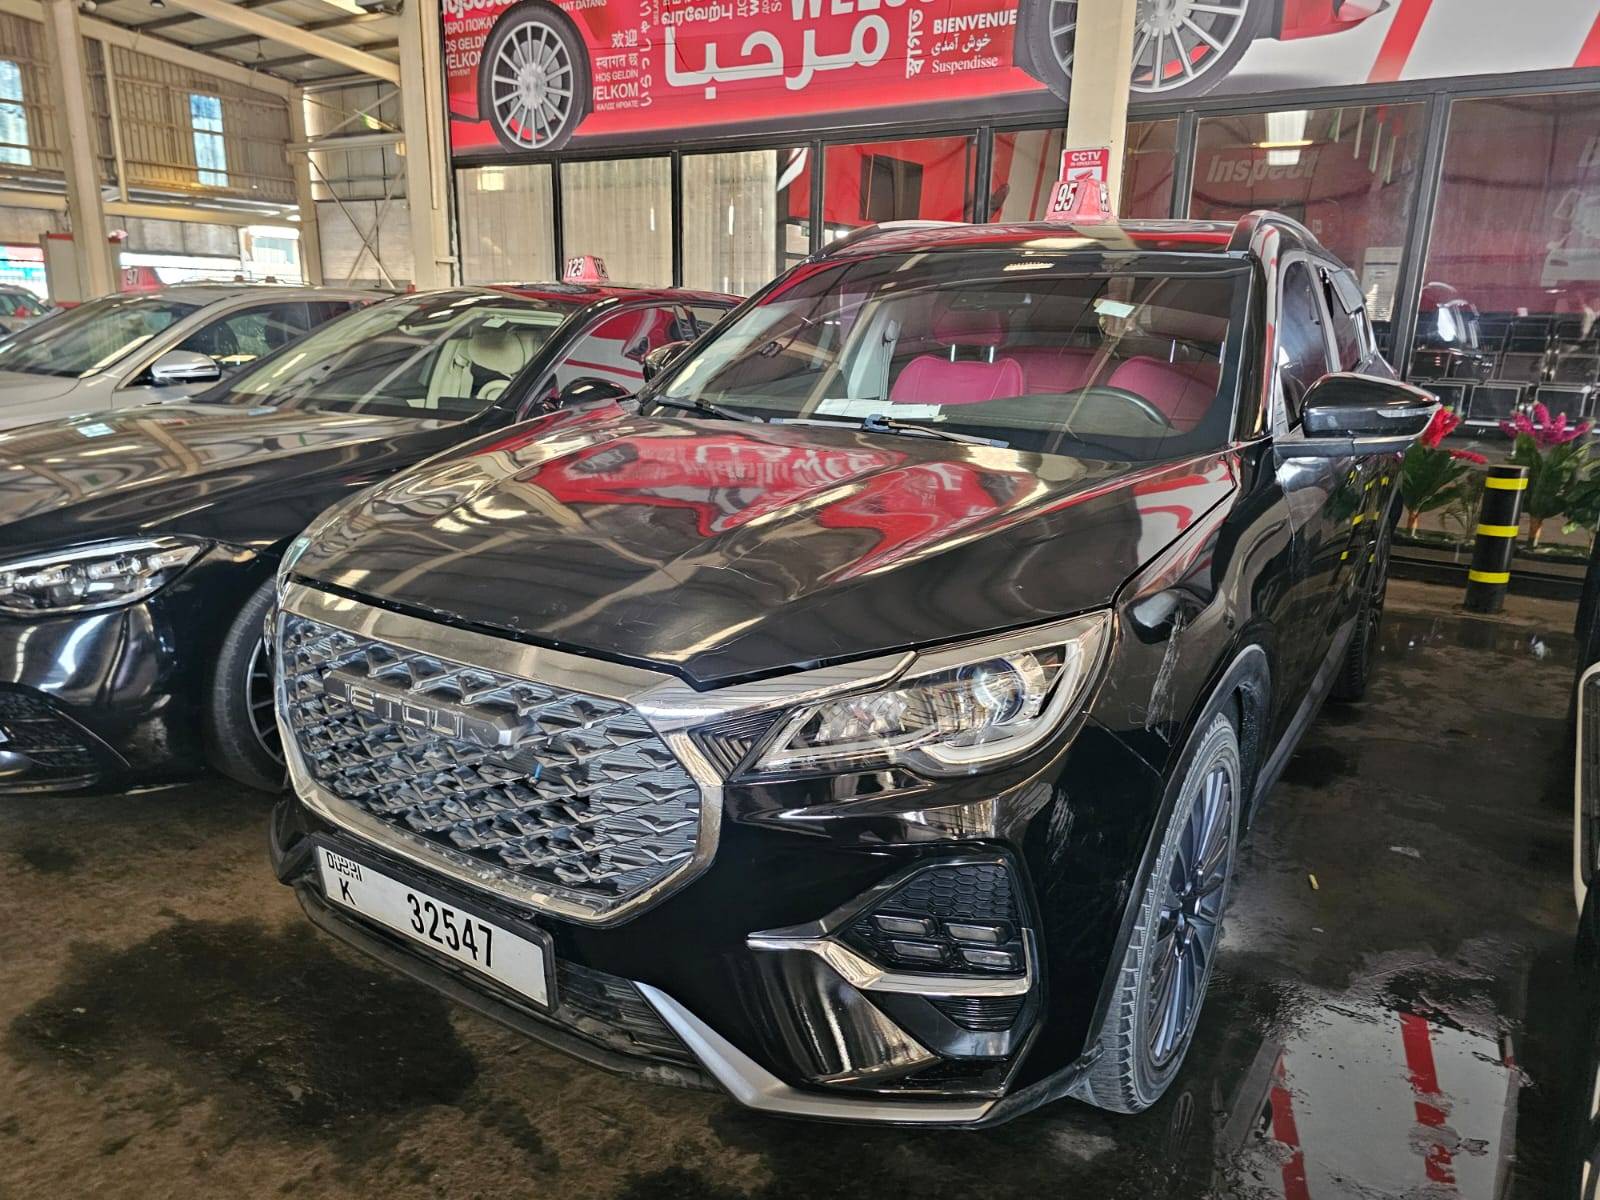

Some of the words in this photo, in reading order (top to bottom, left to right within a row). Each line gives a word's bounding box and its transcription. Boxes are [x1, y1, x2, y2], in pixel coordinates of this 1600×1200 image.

[933, 9, 1018, 35] BIENVENUE
[611, 28, 639, 48] 欢迎
[905, 7, 924, 79] স্বাগত
[664, 14, 890, 100] مرحبا
[931, 55, 999, 75] Suspendisse
[1071, 151, 1102, 162] CCTV
[1055, 183, 1078, 211] 95
[128, 269, 138, 285] 97
[567, 258, 584, 277] 123
[339, 878, 356, 905] K
[407, 893, 494, 968] 32547
